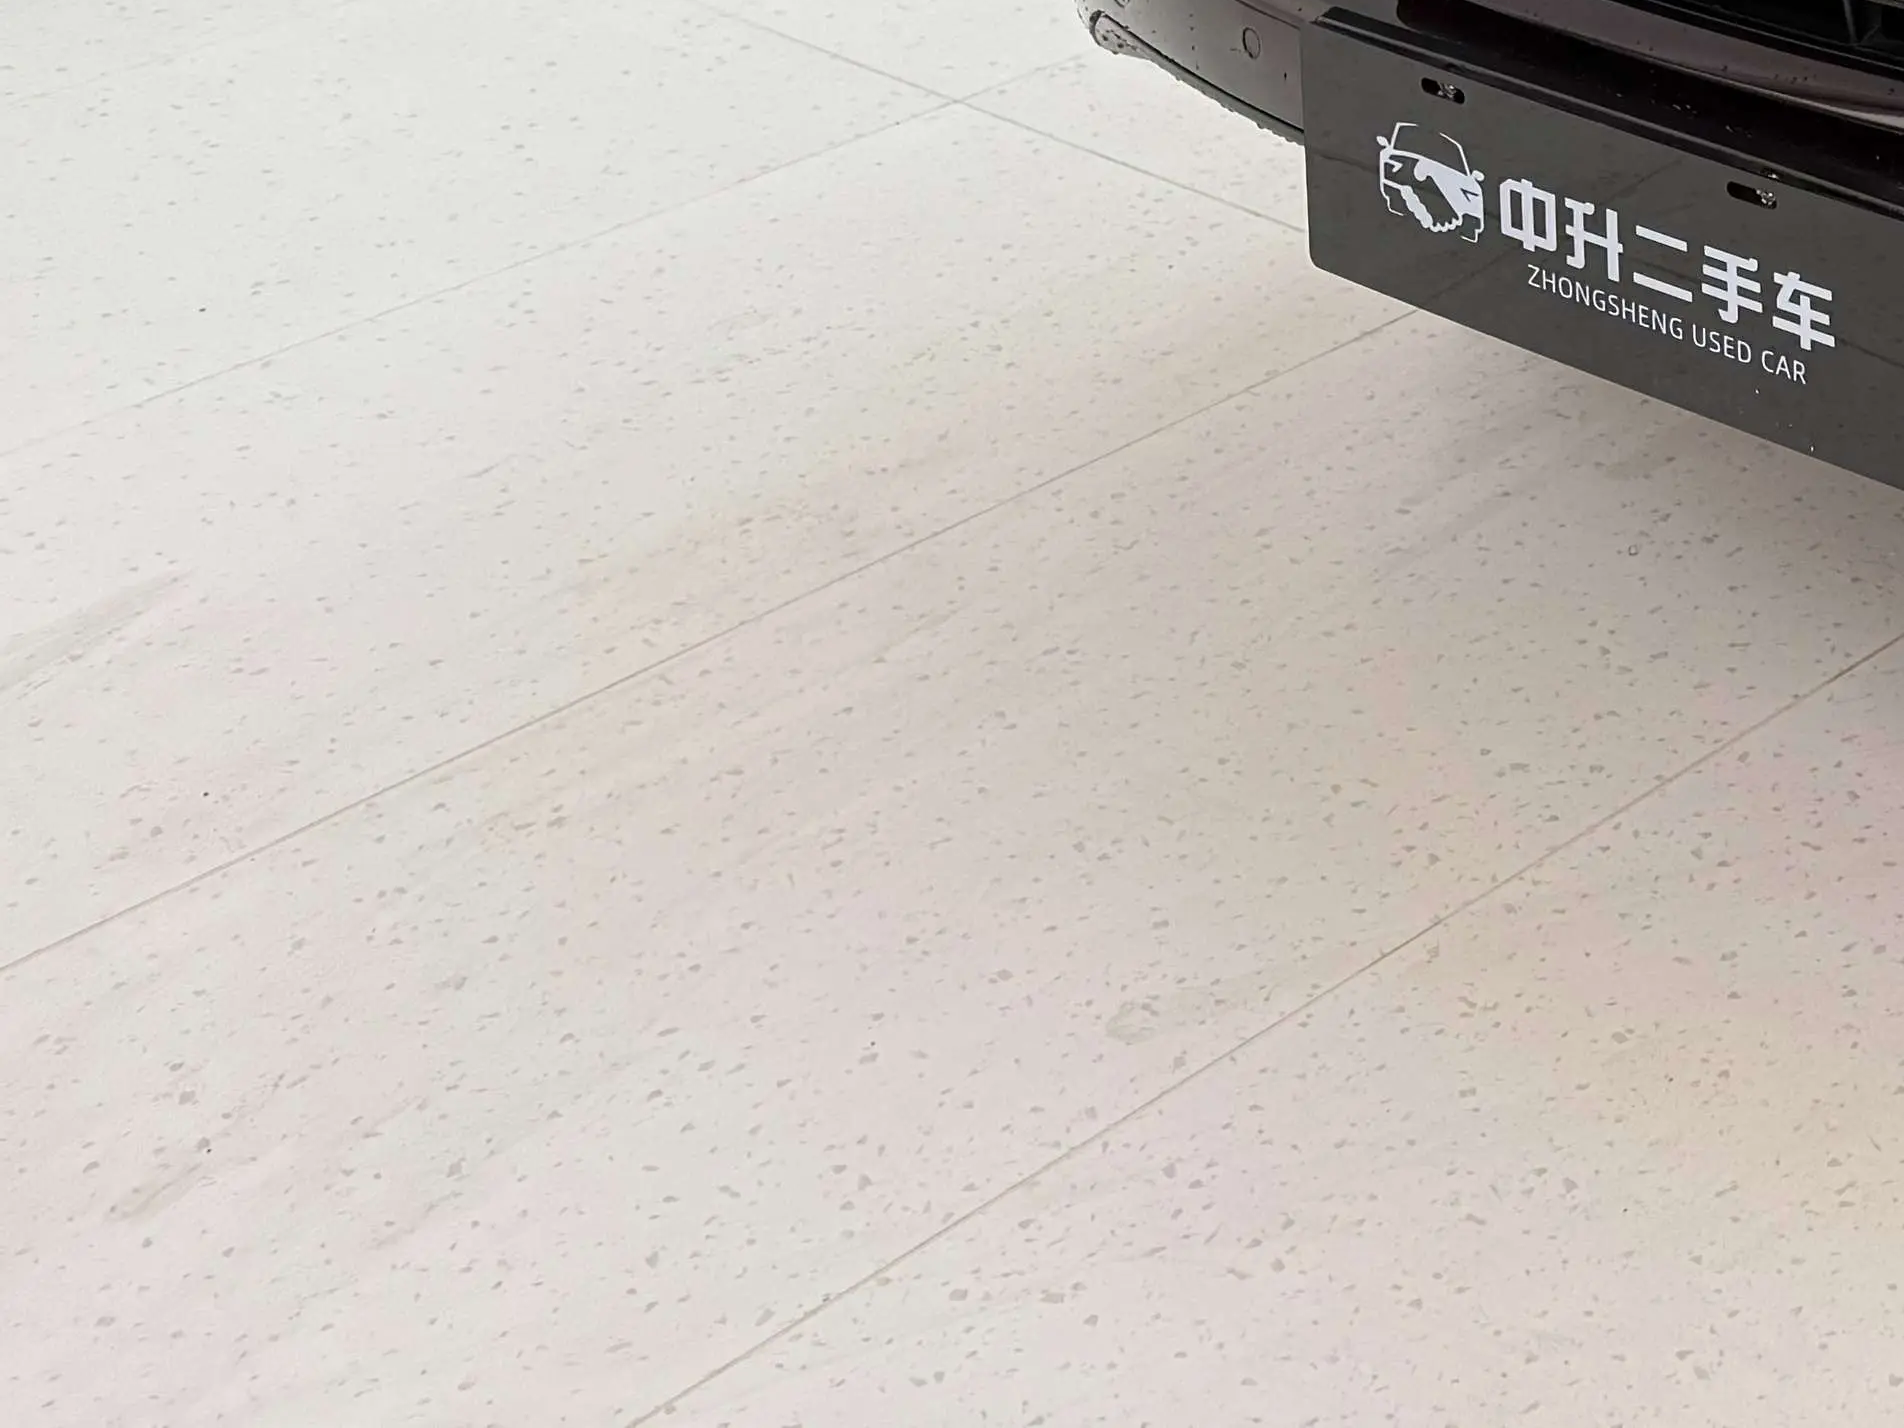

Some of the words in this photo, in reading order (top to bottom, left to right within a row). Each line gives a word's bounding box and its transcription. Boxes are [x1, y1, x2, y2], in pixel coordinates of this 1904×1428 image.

[1500, 178, 1836, 351] 中升二手车
[1526, 263, 1683, 340] ZHONGSHENG
[1692, 323, 1752, 365] USED
[1760, 349, 1808, 386] CAR
